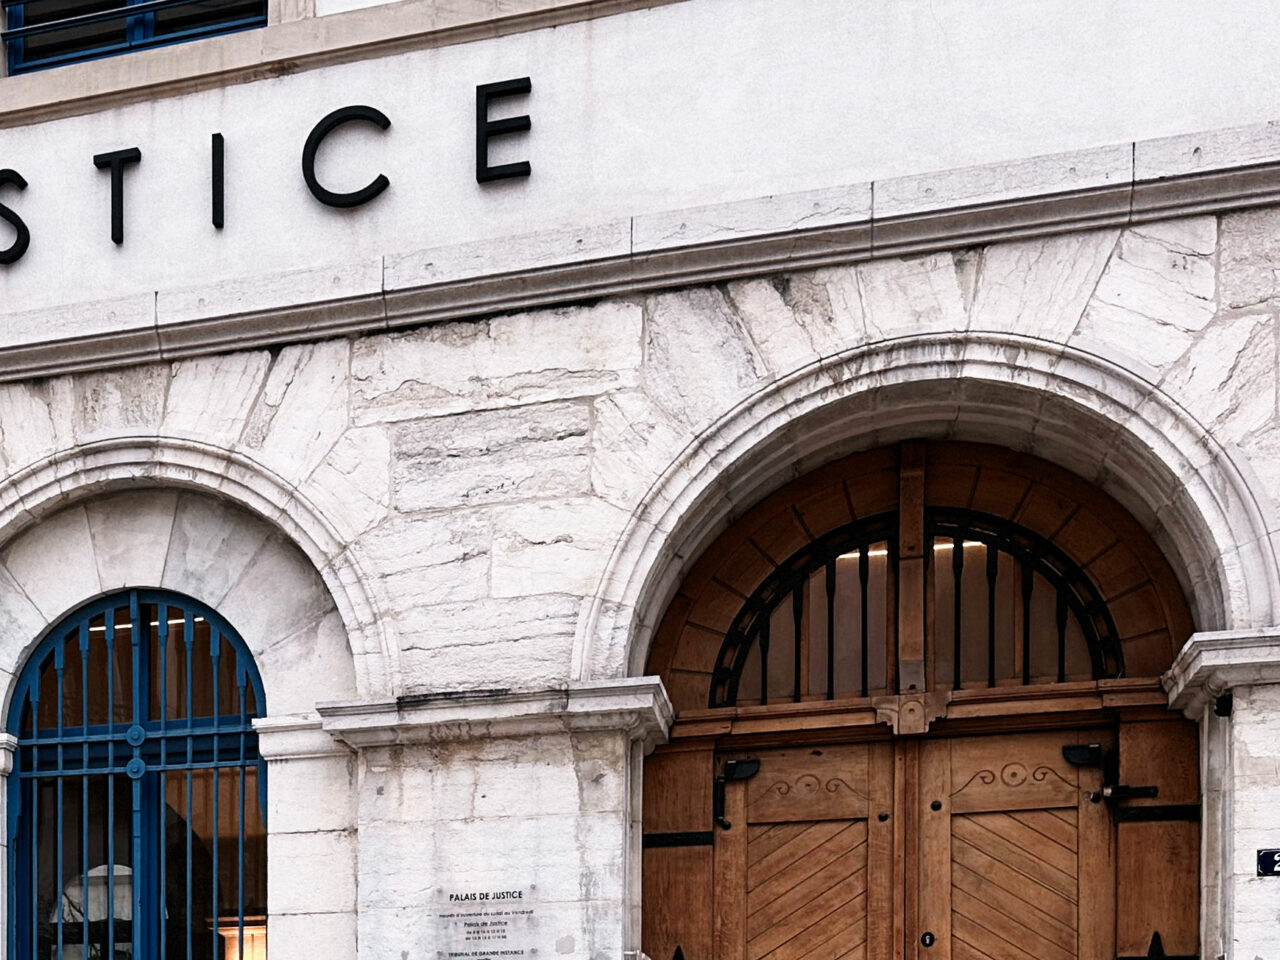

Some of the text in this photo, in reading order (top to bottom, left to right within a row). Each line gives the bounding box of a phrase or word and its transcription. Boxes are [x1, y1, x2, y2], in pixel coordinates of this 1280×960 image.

[449, 891, 523, 901] PALAIS DE JUSTICE
